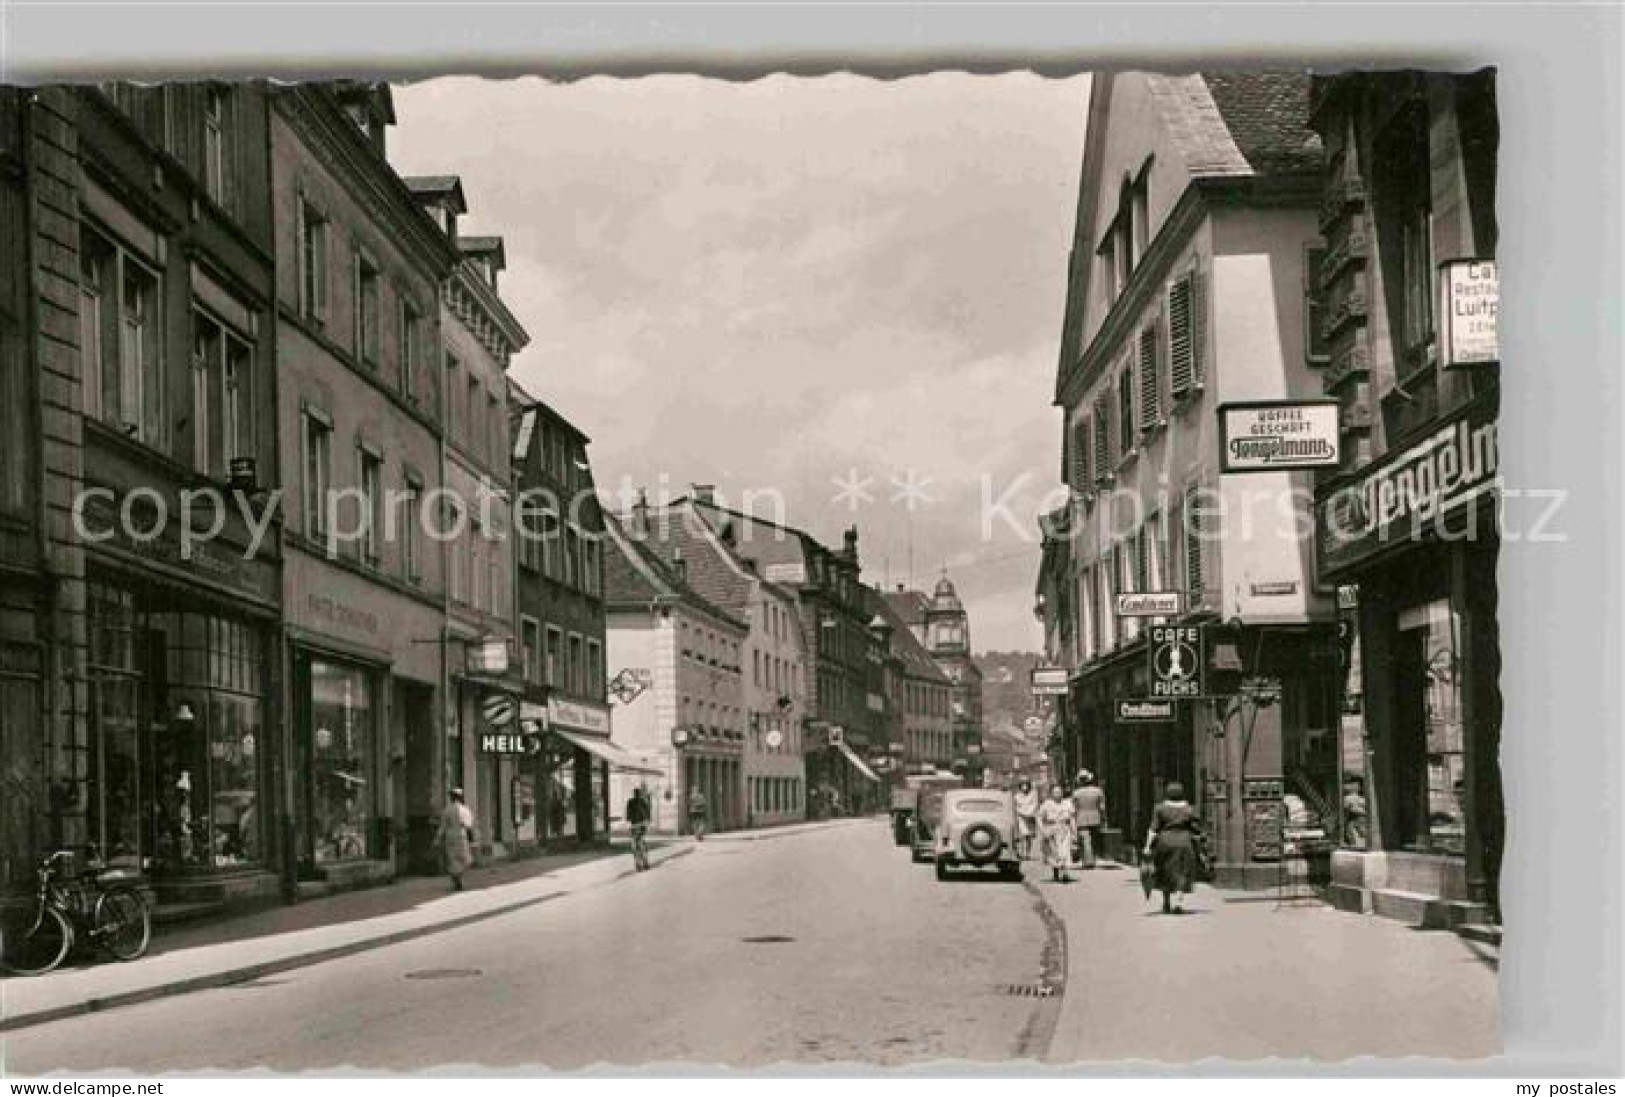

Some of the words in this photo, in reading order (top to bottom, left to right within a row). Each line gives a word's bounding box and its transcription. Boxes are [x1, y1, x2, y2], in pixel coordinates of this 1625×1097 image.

[1230, 436, 1336, 463] Tengelmann
[1153, 628, 1199, 641] CAFE
[1154, 681, 1199, 695] FUCHS
[482, 735, 525, 752] HEIL
